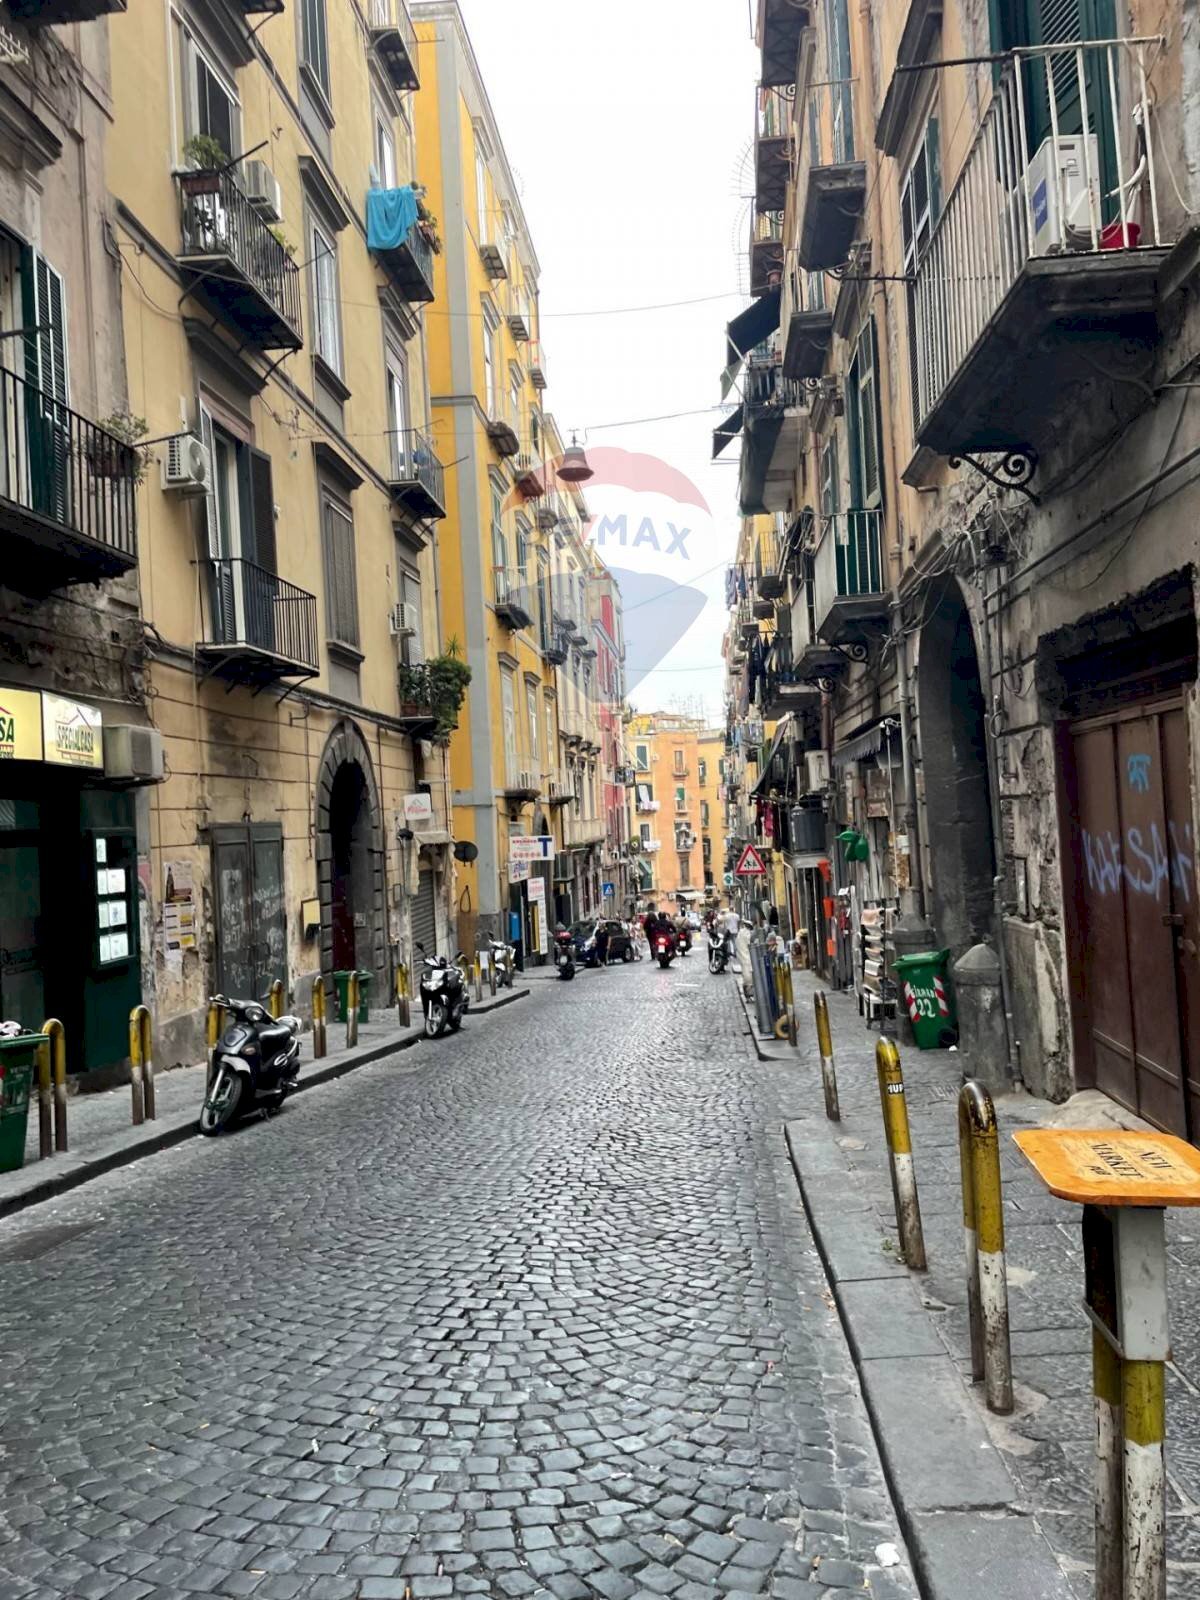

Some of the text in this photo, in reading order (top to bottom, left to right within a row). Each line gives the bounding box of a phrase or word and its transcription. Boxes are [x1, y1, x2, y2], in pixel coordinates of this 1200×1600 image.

[0, 717, 14, 742] SA
[537, 837, 553, 857] T
[917, 998, 936, 1017] 22
[1090, 1143, 1145, 1178] MARKET
